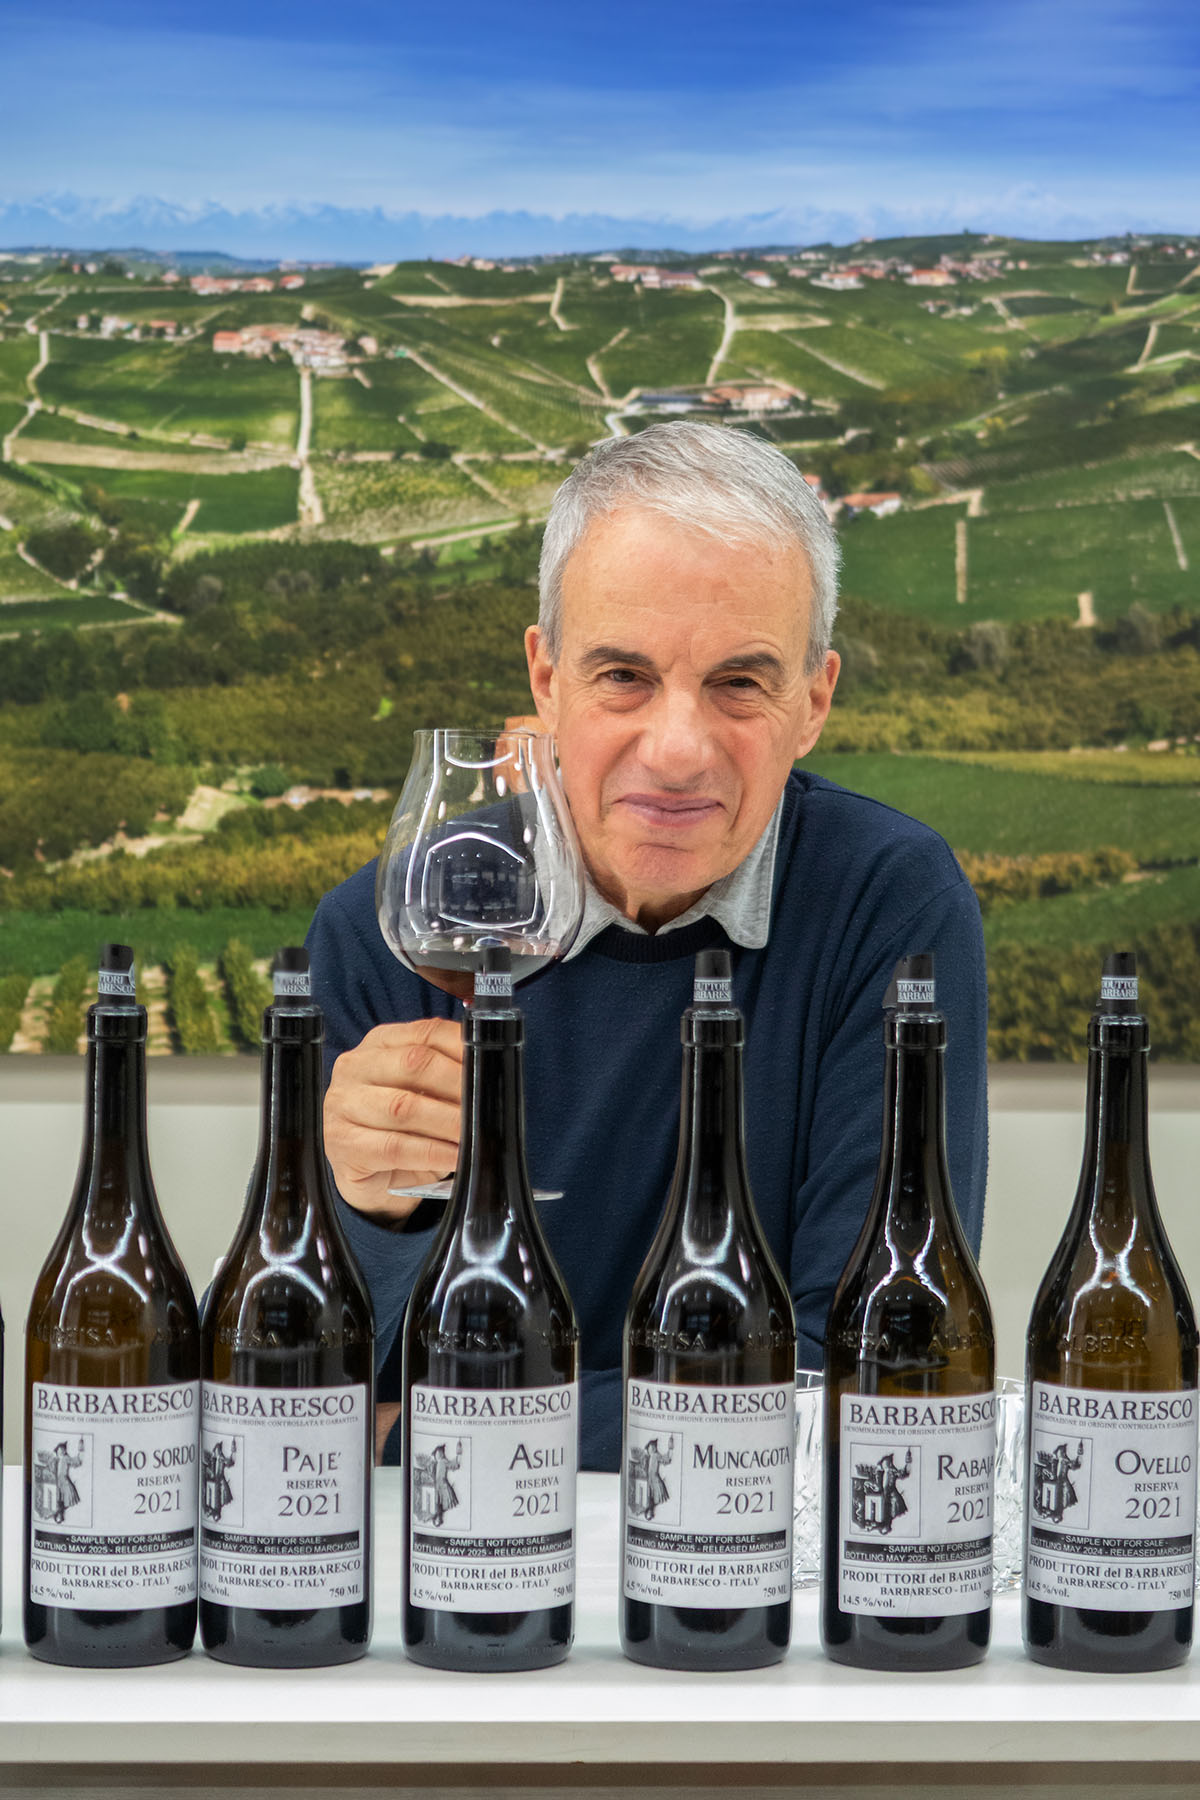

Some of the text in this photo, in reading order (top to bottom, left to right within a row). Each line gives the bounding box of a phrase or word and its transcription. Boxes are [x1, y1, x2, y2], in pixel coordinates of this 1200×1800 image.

[38, 1389, 193, 1414] BARBARESCO
[202, 1390, 354, 1418] BARBARESCO
[415, 1391, 571, 1417] BARBARESCO
[632, 1386, 786, 1414] BARBARESCO
[1039, 1392, 1192, 1421] BARBARESCO
[850, 1399, 995, 1426] BARBARESCO
[110, 1444, 195, 1470] RIO SORDO
[509, 1443, 564, 1470] ASILI
[693, 1444, 791, 1470] MUNCAGOTA
[1115, 1450, 1191, 1475] OVELLO
[137, 1475, 181, 1487] RISERVA
[287, 1479, 337, 1489] RISERVA
[516, 1476, 559, 1490] RISERVA
[726, 1475, 772, 1487] RISERVA
[1134, 1482, 1179, 1492] RISERVA
[134, 1490, 180, 1515] 2021
[278, 1492, 340, 1517] 2021
[512, 1492, 558, 1517] 2021
[717, 1491, 774, 1515] 2021
[1125, 1497, 1180, 1519] 2021
[947, 1497, 990, 1523] 2021
[71, 1534, 166, 1544] SAMPLE NOT FOR SALE
[224, 1534, 254, 1544] SAMPLE
[257, 1536, 274, 1544] NOT
[278, 1537, 296, 1545] FOR
[299, 1536, 320, 1544] SALE
[450, 1538, 483, 1547] SAMPLE
[507, 1538, 524, 1546] FOR
[527, 1537, 545, 1545] SALE
[660, 1533, 692, 1543] SAMPLE
[695, 1535, 713, 1543] NOT
[716, 1536, 733, 1544] FOR
[1066, 1536, 1164, 1547] SAMPLE NOT FOR SALE
[115, 1544, 159, 1554] RELEASED
[160, 1540, 183, 1550] MARCH
[223, 1543, 238, 1551] MAY
[240, 1544, 257, 1553] 2025
[264, 1546, 312, 1554] RELEASED
[314, 1543, 343, 1553] MARCH
[448, 1547, 465, 1556] MAY
[494, 1547, 537, 1556] RELEASED
[658, 1542, 674, 1550] MAY
[676, 1544, 695, 1552] 2025
[703, 1545, 747, 1553] RELEASED
[749, 1543, 773, 1552] MARCH
[889, 1545, 924, 1553] SAMPLE
[964, 1541, 980, 1550] SALE
[1063, 1544, 1080, 1553] MAY
[1110, 1548, 1156, 1557] RELEASED
[626, 1554, 788, 1575] RODUTTORI del BARBARESCO
[845, 1552, 884, 1561] BOTTLING
[886, 1554, 905, 1562] MAY
[908, 1555, 927, 1563] 2025
[32, 1558, 105, 1576] PRODUTTORI
[110, 1566, 127, 1576] del
[259, 1566, 276, 1576] del
[281, 1560, 360, 1576] BARBARESCO
[490, 1568, 505, 1579] del
[1029, 1555, 1192, 1578] PRODUTTORI del BARBARESCO
[62, 1576, 170, 1588] BARBARESCO ITALY
[218, 1575, 284, 1588] BARBARESCO
[294, 1578, 326, 1588] ITALY
[651, 1574, 759, 1587] BARBARESCO ITALY
[843, 1569, 925, 1584] PRODUTTORI
[929, 1573, 945, 1584] del
[1057, 1576, 1167, 1590] BARBARESCO ITALY
[329, 1584, 360, 1598] 750 ML
[441, 1579, 550, 1591] BARBARESCO ITALY
[880, 1581, 982, 1596] BARBARESCO ITALY
[843, 1595, 860, 1606] 14.5
